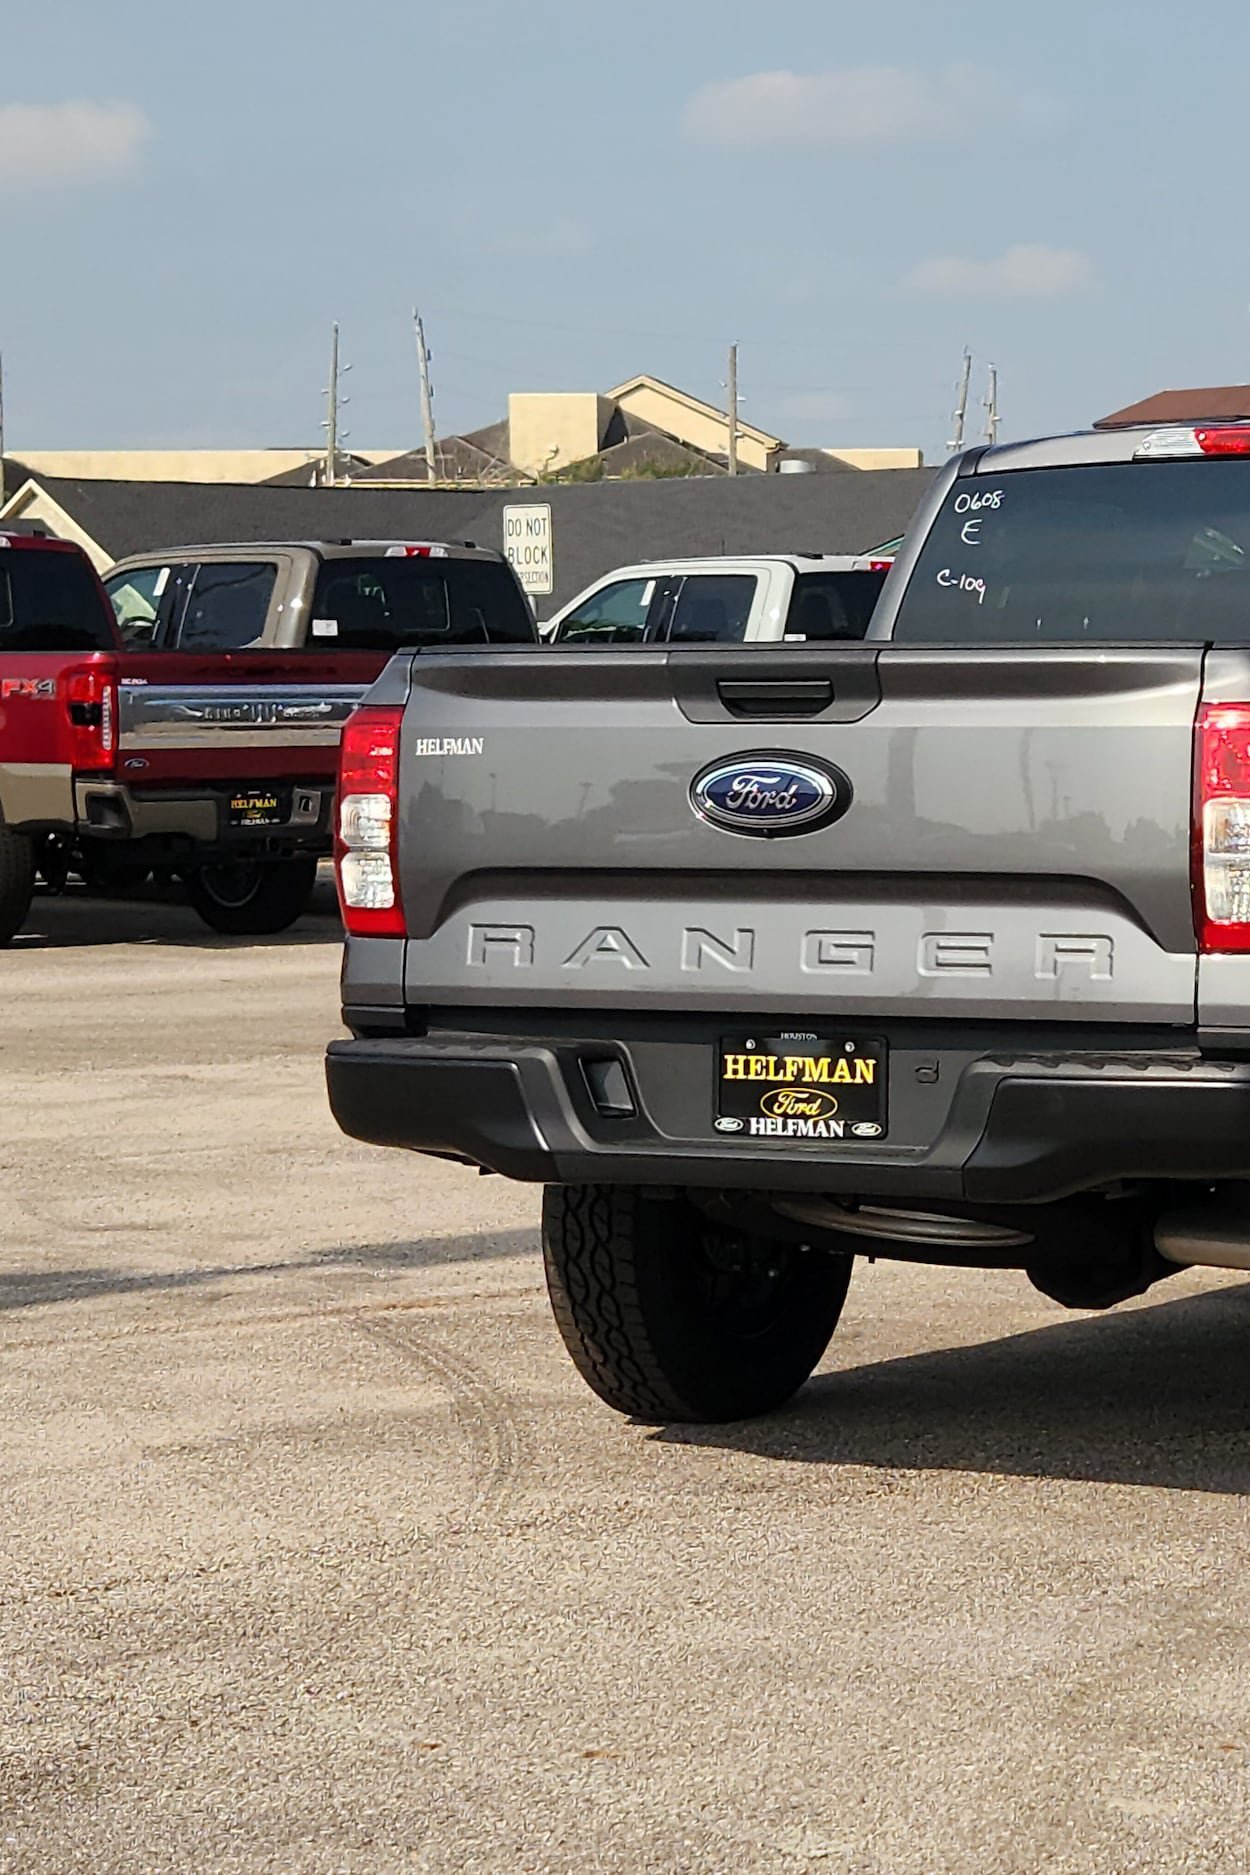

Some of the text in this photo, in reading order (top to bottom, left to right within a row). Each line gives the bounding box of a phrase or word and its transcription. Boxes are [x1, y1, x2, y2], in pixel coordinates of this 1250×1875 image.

[954, 490, 1005, 513] 0608
[507, 517, 547, 537] DO NOT
[961, 519, 983, 545] E
[507, 545, 548, 565] BLOCK
[2, 678, 54, 697] FX4
[415, 738, 484, 756] HELFMAN
[725, 774, 797, 810] Ford
[465, 922, 1114, 980] RANGER
[722, 1054, 877, 1084] HELFMAN
[773, 1091, 822, 1116] Ford
[749, 1117, 845, 1138] HELFMAN
